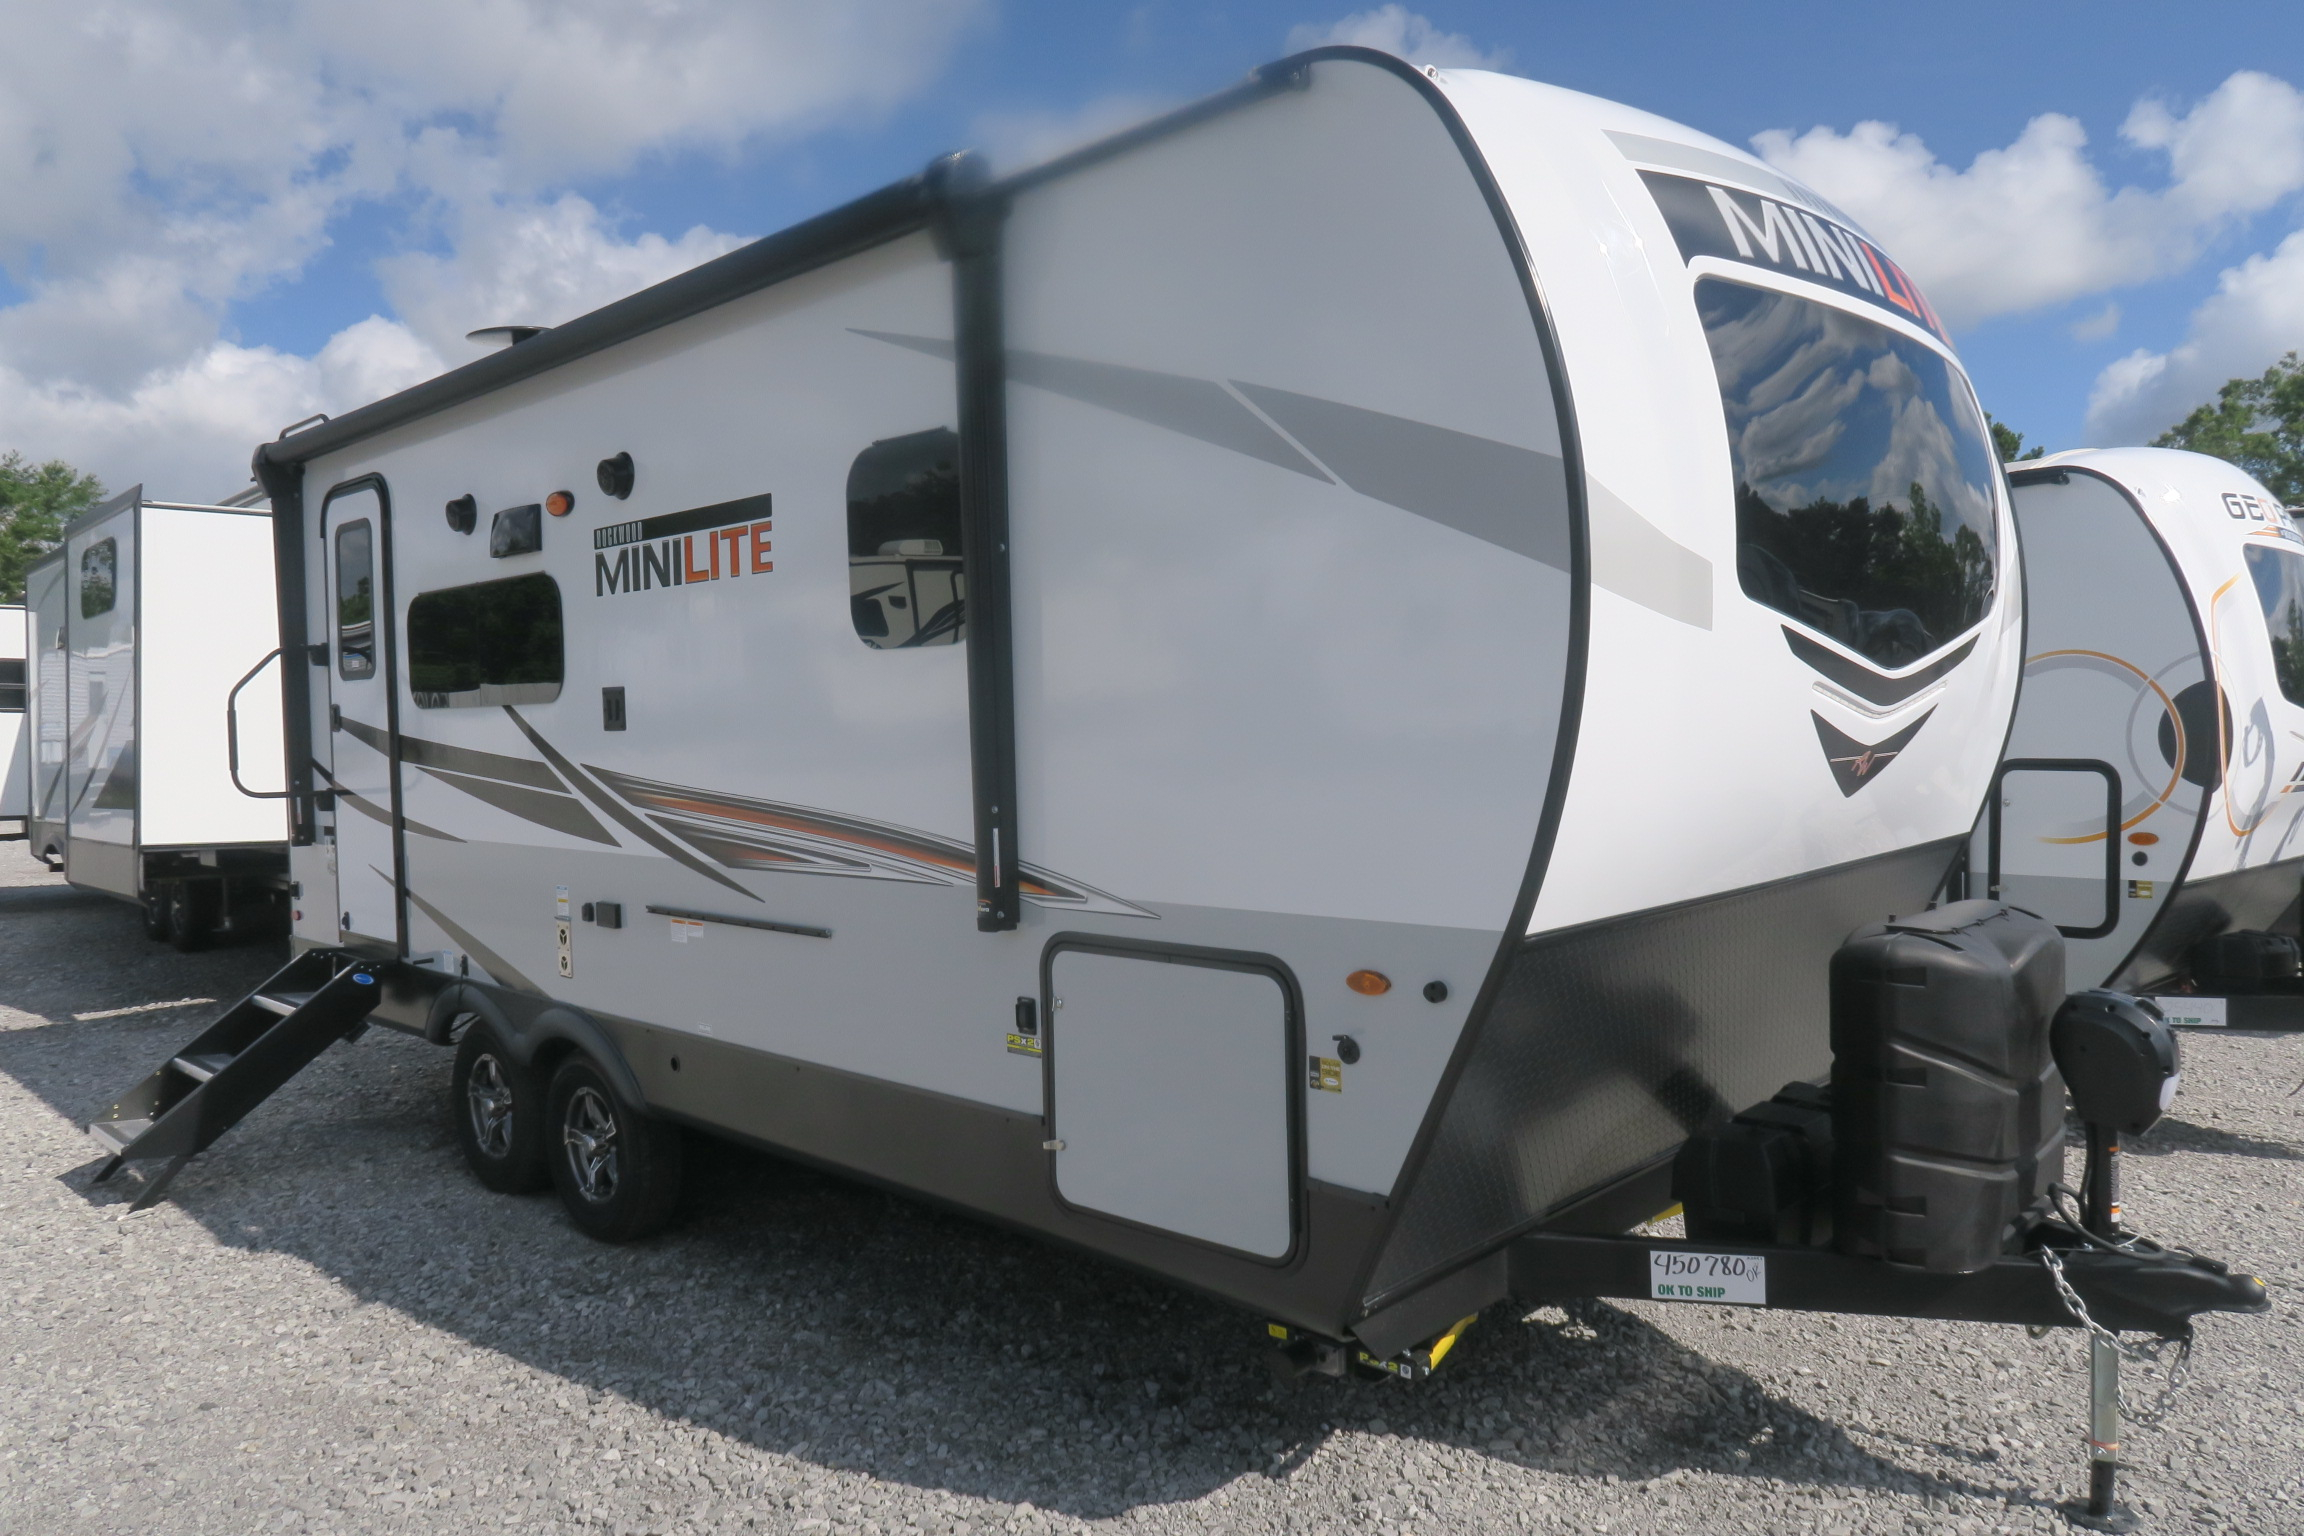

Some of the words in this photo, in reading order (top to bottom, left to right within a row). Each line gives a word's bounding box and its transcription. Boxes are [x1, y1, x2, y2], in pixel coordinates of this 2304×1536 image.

[596, 521, 643, 548] ROCKWOOD
[595, 520, 773, 597] MINILITE
[1658, 1284, 1675, 1296] OK
[1678, 1285, 1693, 1297] TO
[1697, 1286, 1726, 1298] SHIP
